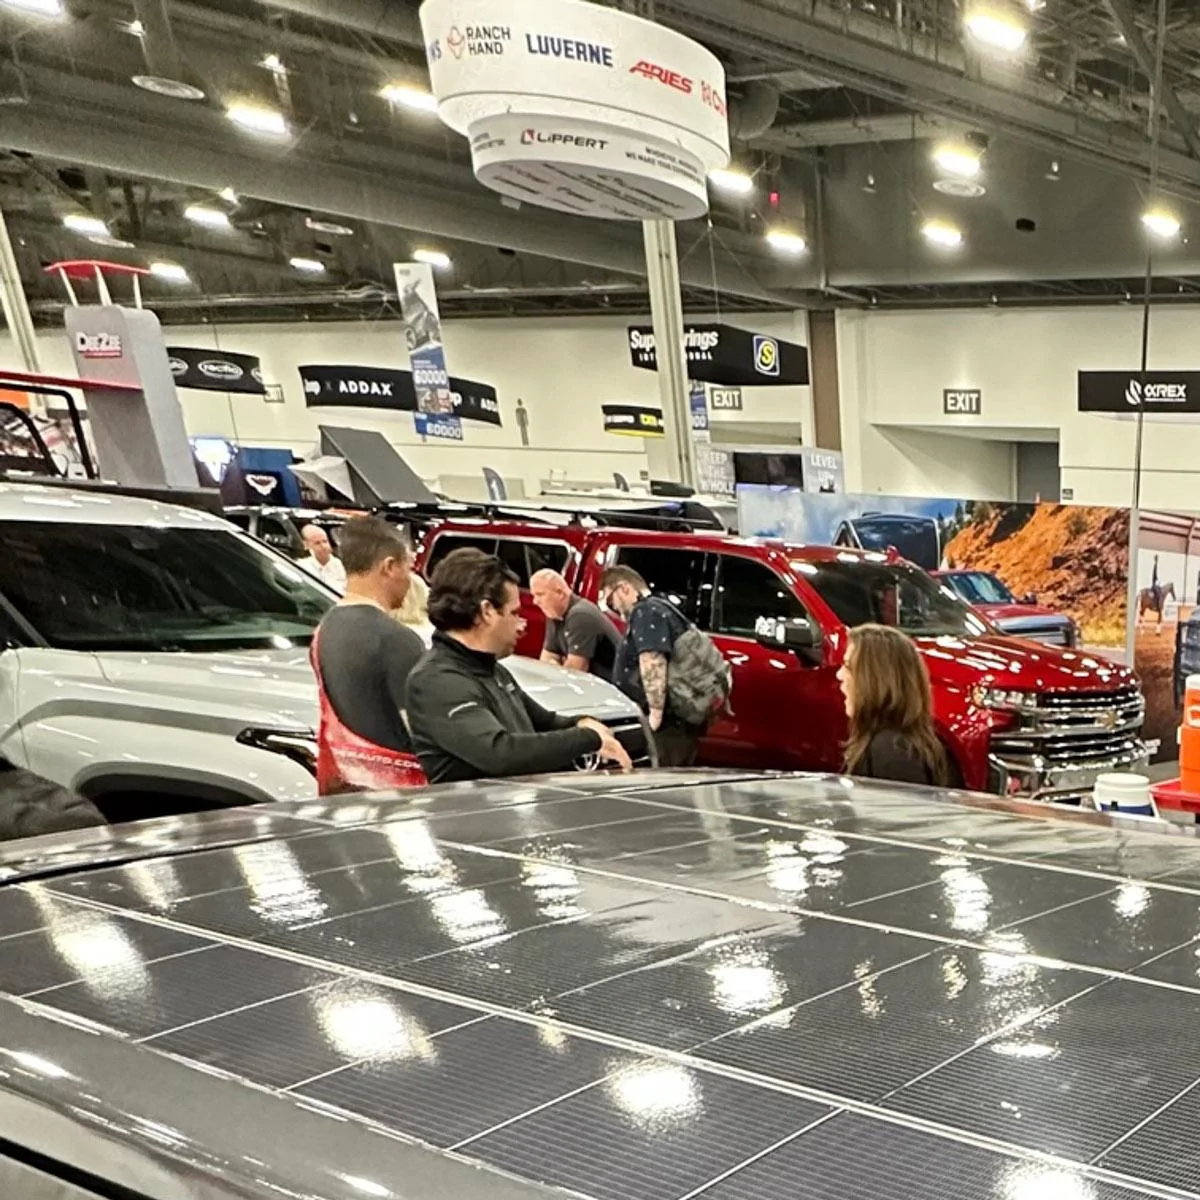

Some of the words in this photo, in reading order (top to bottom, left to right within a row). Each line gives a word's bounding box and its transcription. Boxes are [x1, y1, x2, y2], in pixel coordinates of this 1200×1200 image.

[465, 26, 511, 40] RANCH
[468, 42, 504, 55] HAND
[525, 33, 613, 68] LUVERNE
[629, 60, 693, 94] ARIES
[339, 380, 393, 396] ADDAX
[714, 390, 739, 407] EXIT
[947, 393, 978, 411] EXIT
